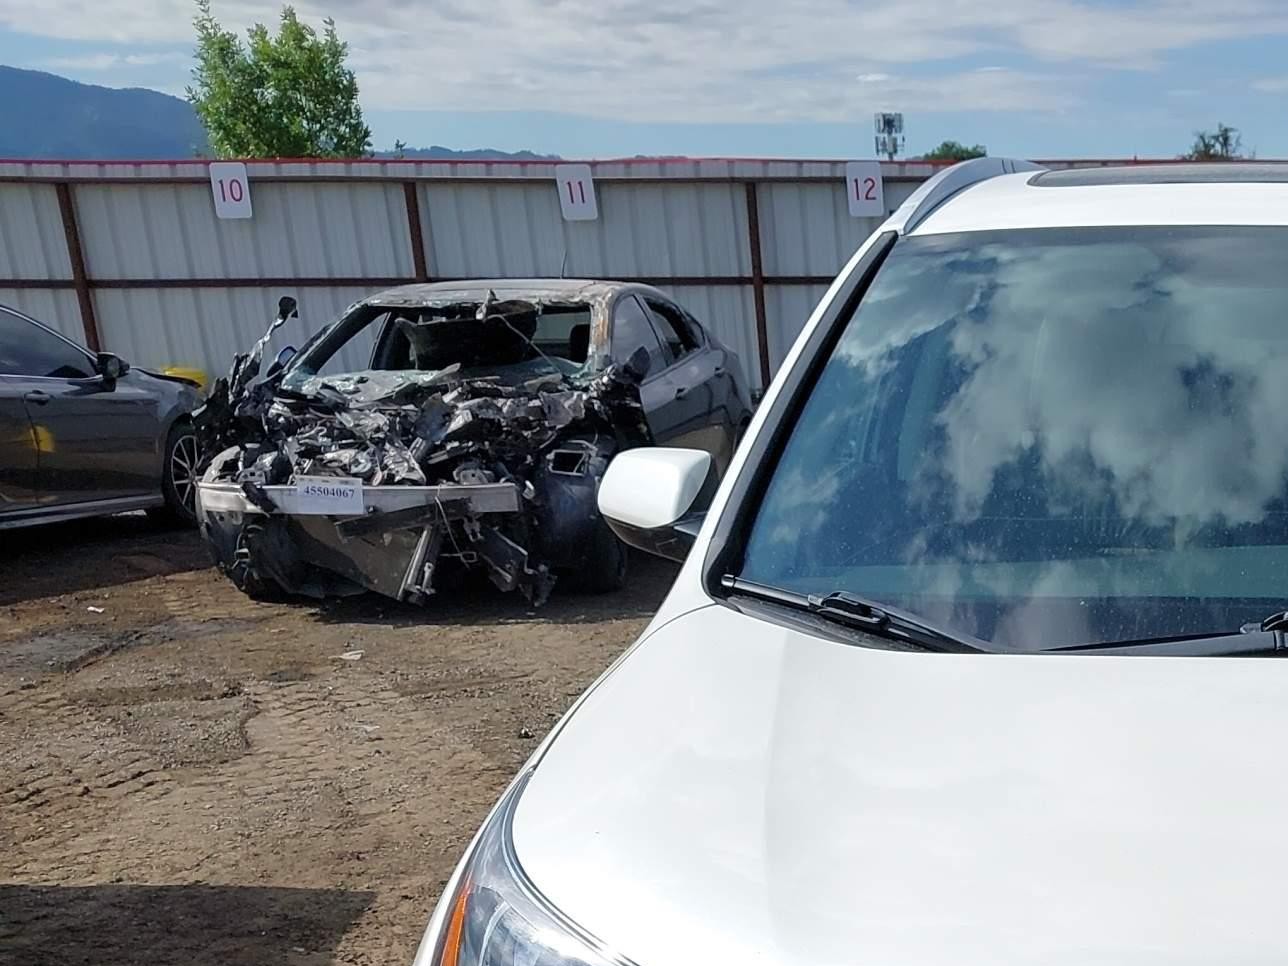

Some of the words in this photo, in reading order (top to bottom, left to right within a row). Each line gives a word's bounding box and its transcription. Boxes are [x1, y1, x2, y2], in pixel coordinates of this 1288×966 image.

[218, 178, 243, 202] 10
[566, 180, 585, 204] 11
[853, 177, 877, 201] 12
[303, 485, 355, 498] 45504067
